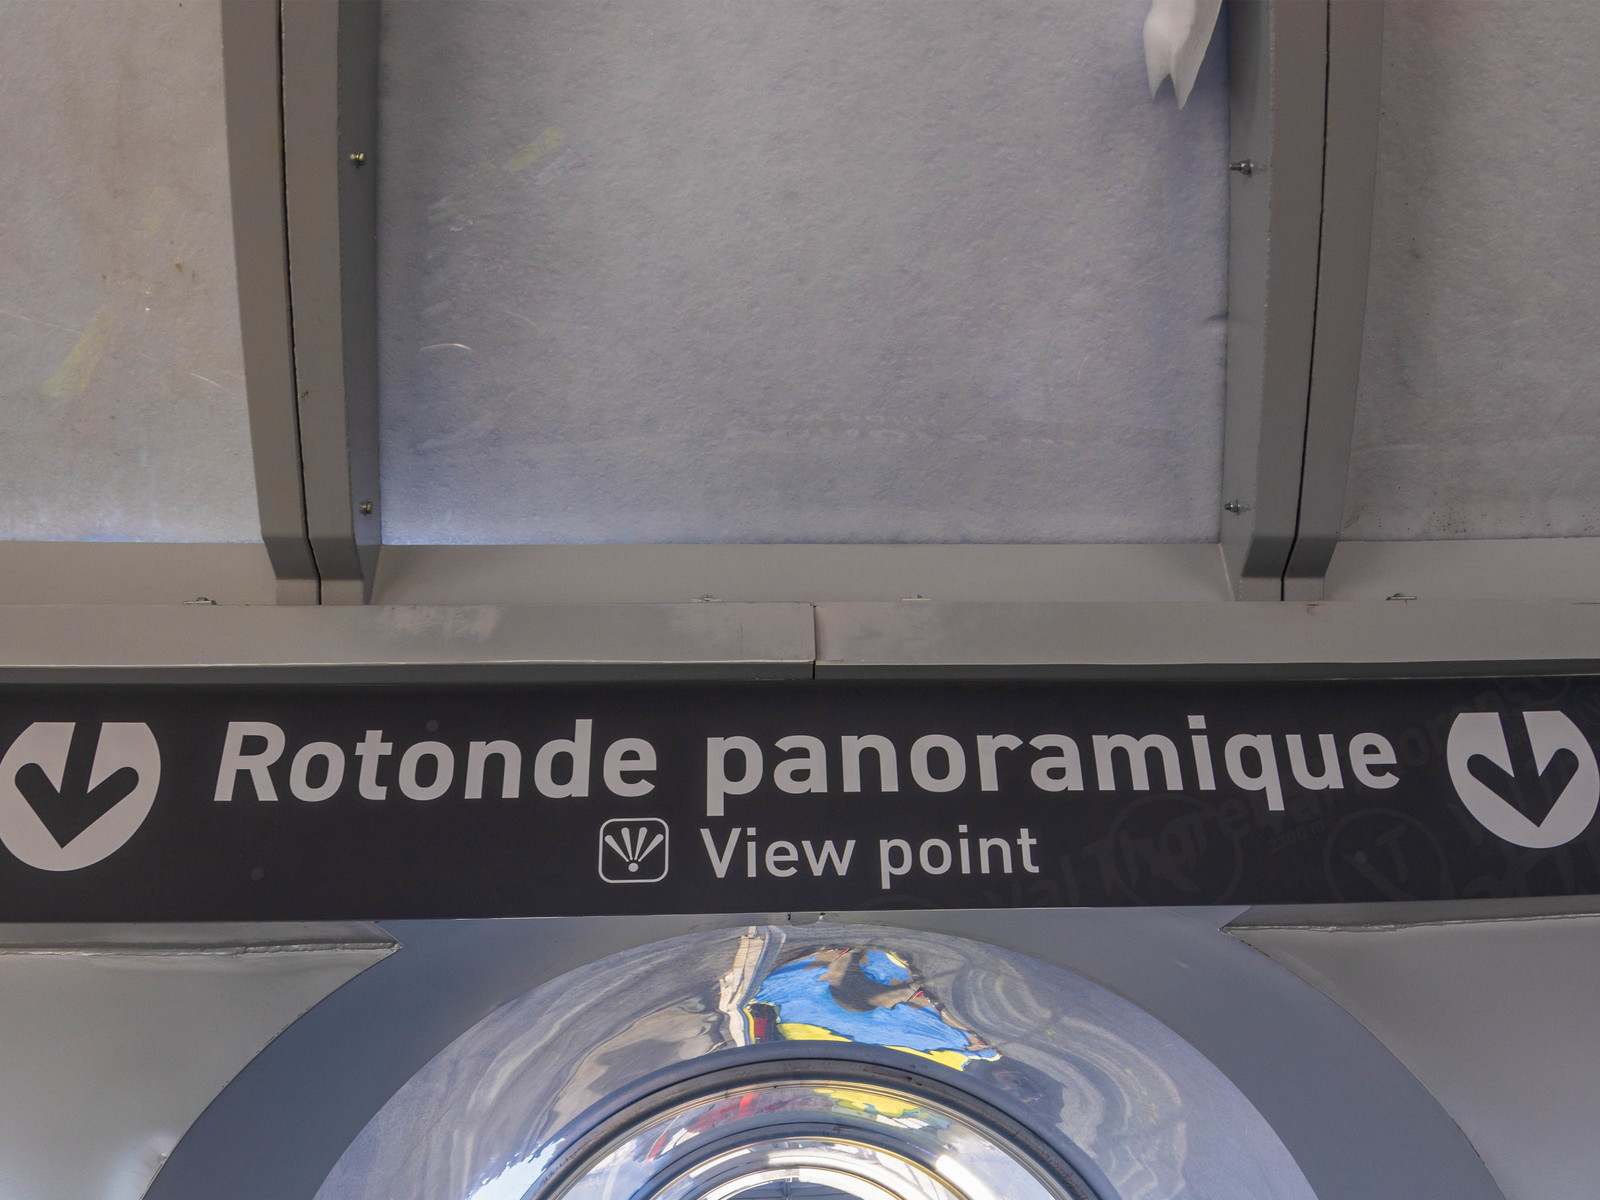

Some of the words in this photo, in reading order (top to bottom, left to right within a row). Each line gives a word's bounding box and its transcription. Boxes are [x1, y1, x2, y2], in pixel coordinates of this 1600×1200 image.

[214, 719, 656, 802] Rotonde
[707, 715, 1399, 816] panoramique
[700, 828, 856, 878] View
[880, 825, 1039, 889] point
